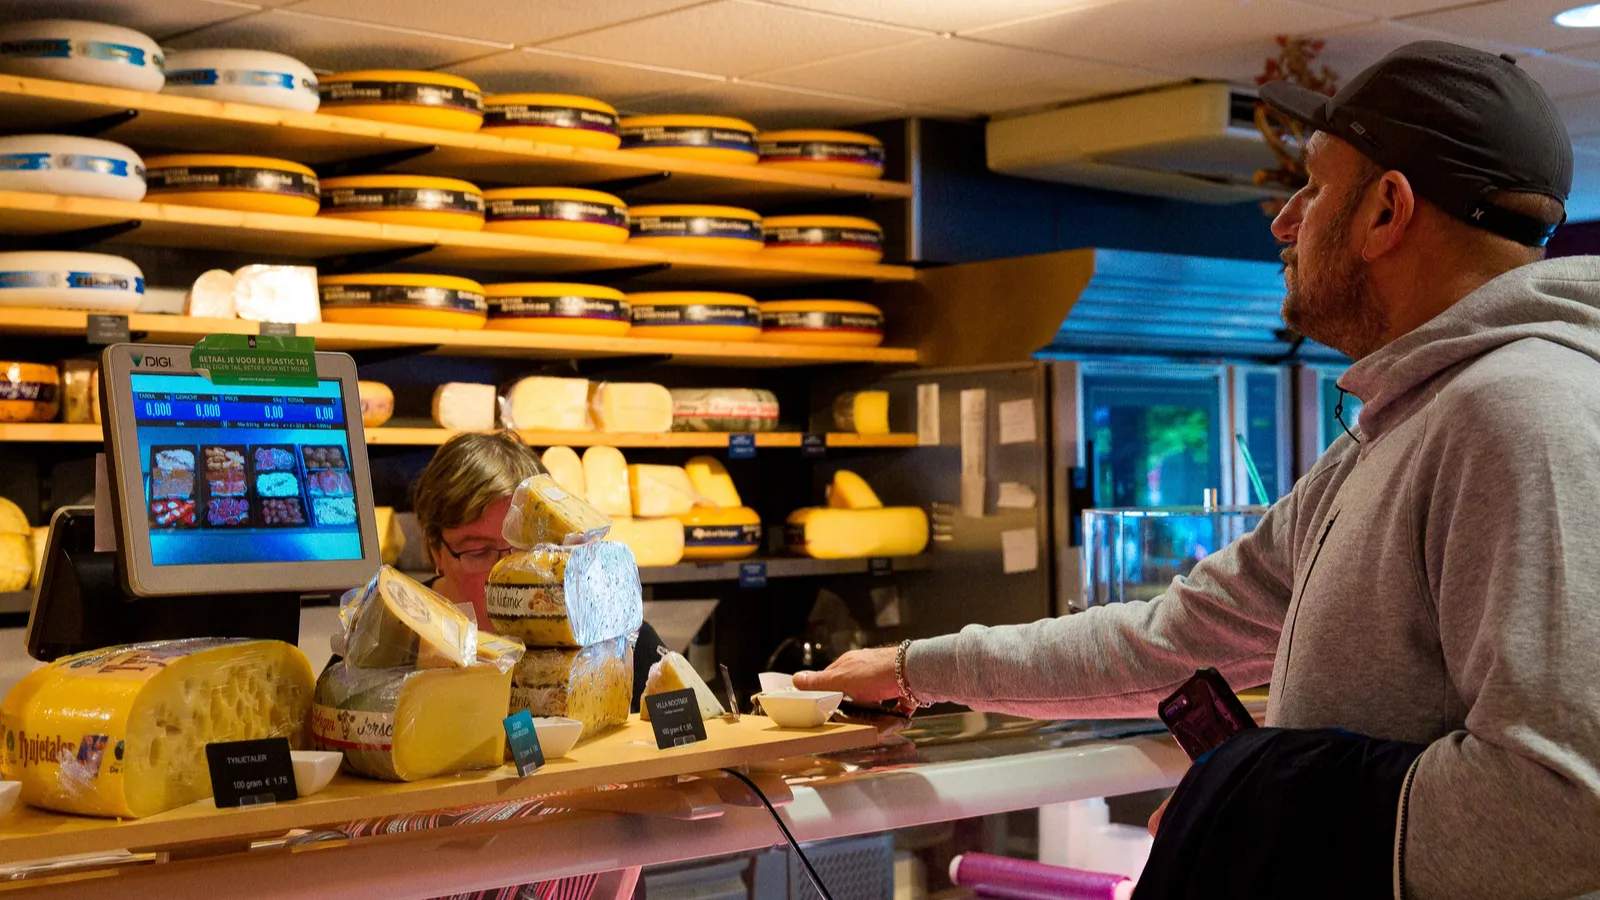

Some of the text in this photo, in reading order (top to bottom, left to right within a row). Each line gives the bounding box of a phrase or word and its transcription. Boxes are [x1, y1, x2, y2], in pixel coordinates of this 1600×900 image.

[145, 356, 172, 367] DIGI
[199, 355, 226, 363] BETAAL
[227, 356, 234, 364] JE
[267, 358, 295, 366] PLASTIC
[145, 402, 172, 418] 0,000
[195, 403, 220, 418] 0,000
[264, 405, 283, 420] 0,00
[315, 406, 334, 420] 0,00
[656, 697, 688, 709] VILLA NOOTMIX
[227, 754, 267, 764] TYNJETALER
[233, 776, 288, 790] 100 gram € 1,75
